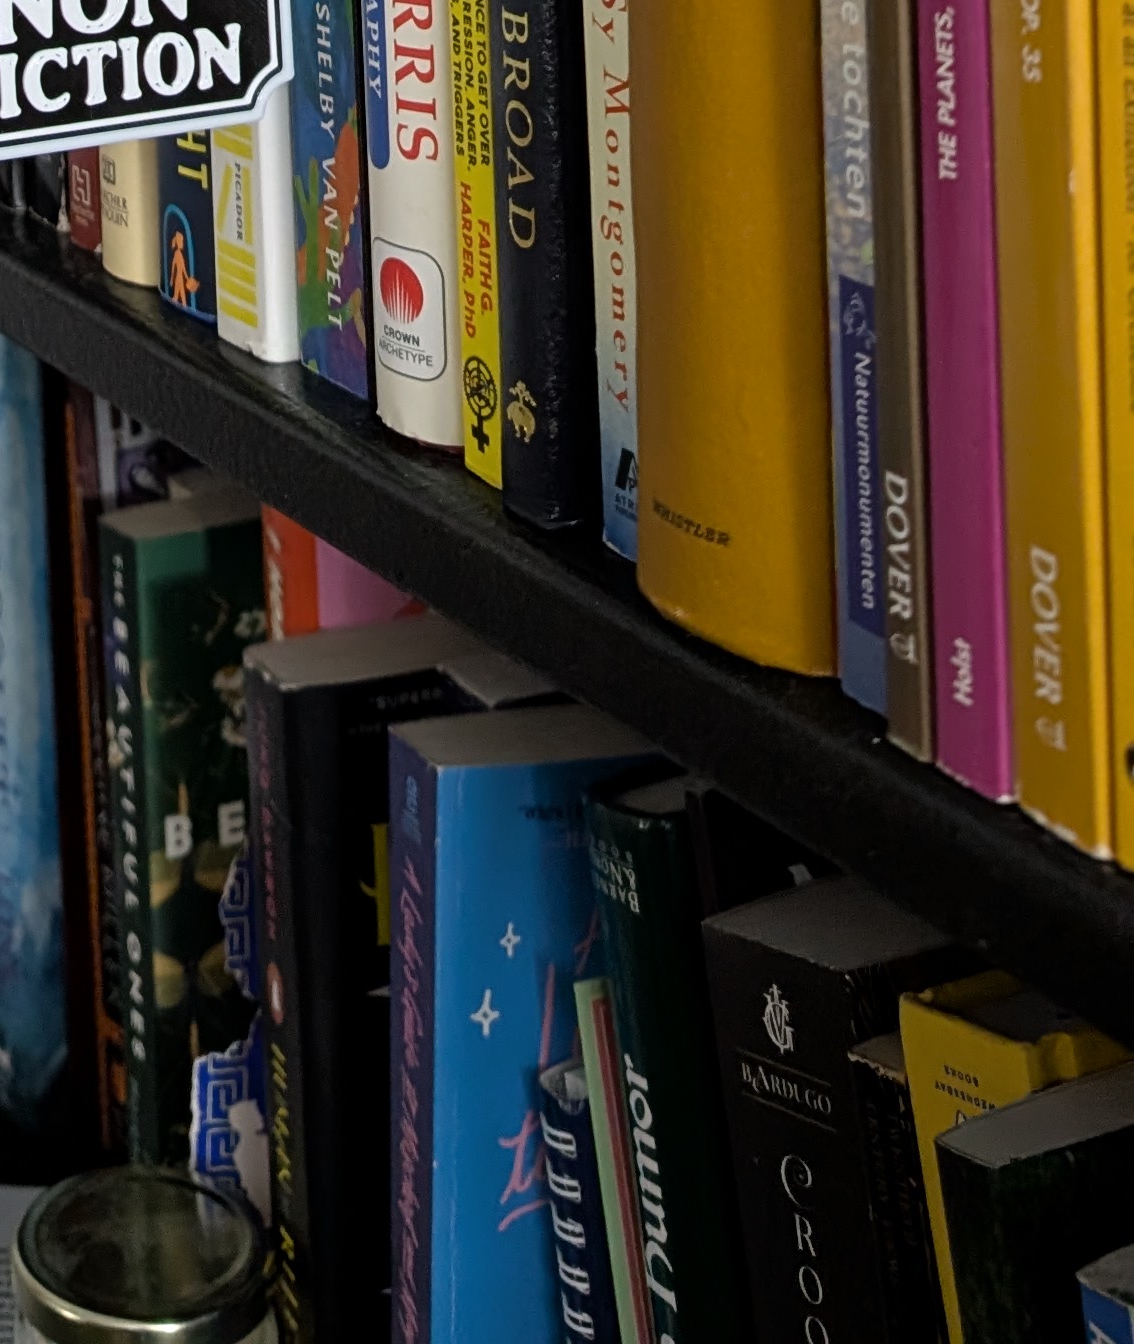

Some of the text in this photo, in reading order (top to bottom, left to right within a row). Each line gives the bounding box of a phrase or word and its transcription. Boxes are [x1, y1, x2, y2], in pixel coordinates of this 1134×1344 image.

[452, 13, 462, 50] AND
[933, 6, 957, 125] PLANETS,
[1021, 45, 1042, 83] 35
[454, 53, 466, 158] TRIGGERS
[478, 70, 488, 108] GET
[479, 112, 490, 167] OVER
[843, 34, 870, 220] tochten
[233, 162, 243, 240] PICADOR
[315, 2, 343, 332] SHELBY VAN PELT
[938, 132, 958, 180] THE
[458, 181, 477, 339] HARPER, PhD
[477, 219, 492, 288] FAITH
[599, 69, 631, 413] Montgomery
[378, 338, 433, 367] ARCHETYPE
[383, 324, 420, 347] CROWN
[854, 353, 875, 609] Natuurmonumenten
[884, 471, 912, 618] DOVER
[1030, 545, 1061, 705] DOVER
[112, 616, 139, 910] BEAUTIFUL
[125, 930, 146, 1061] ONES
[741, 1061, 832, 1114] BARDUGO
[780, 1153, 830, 1344] CROO
